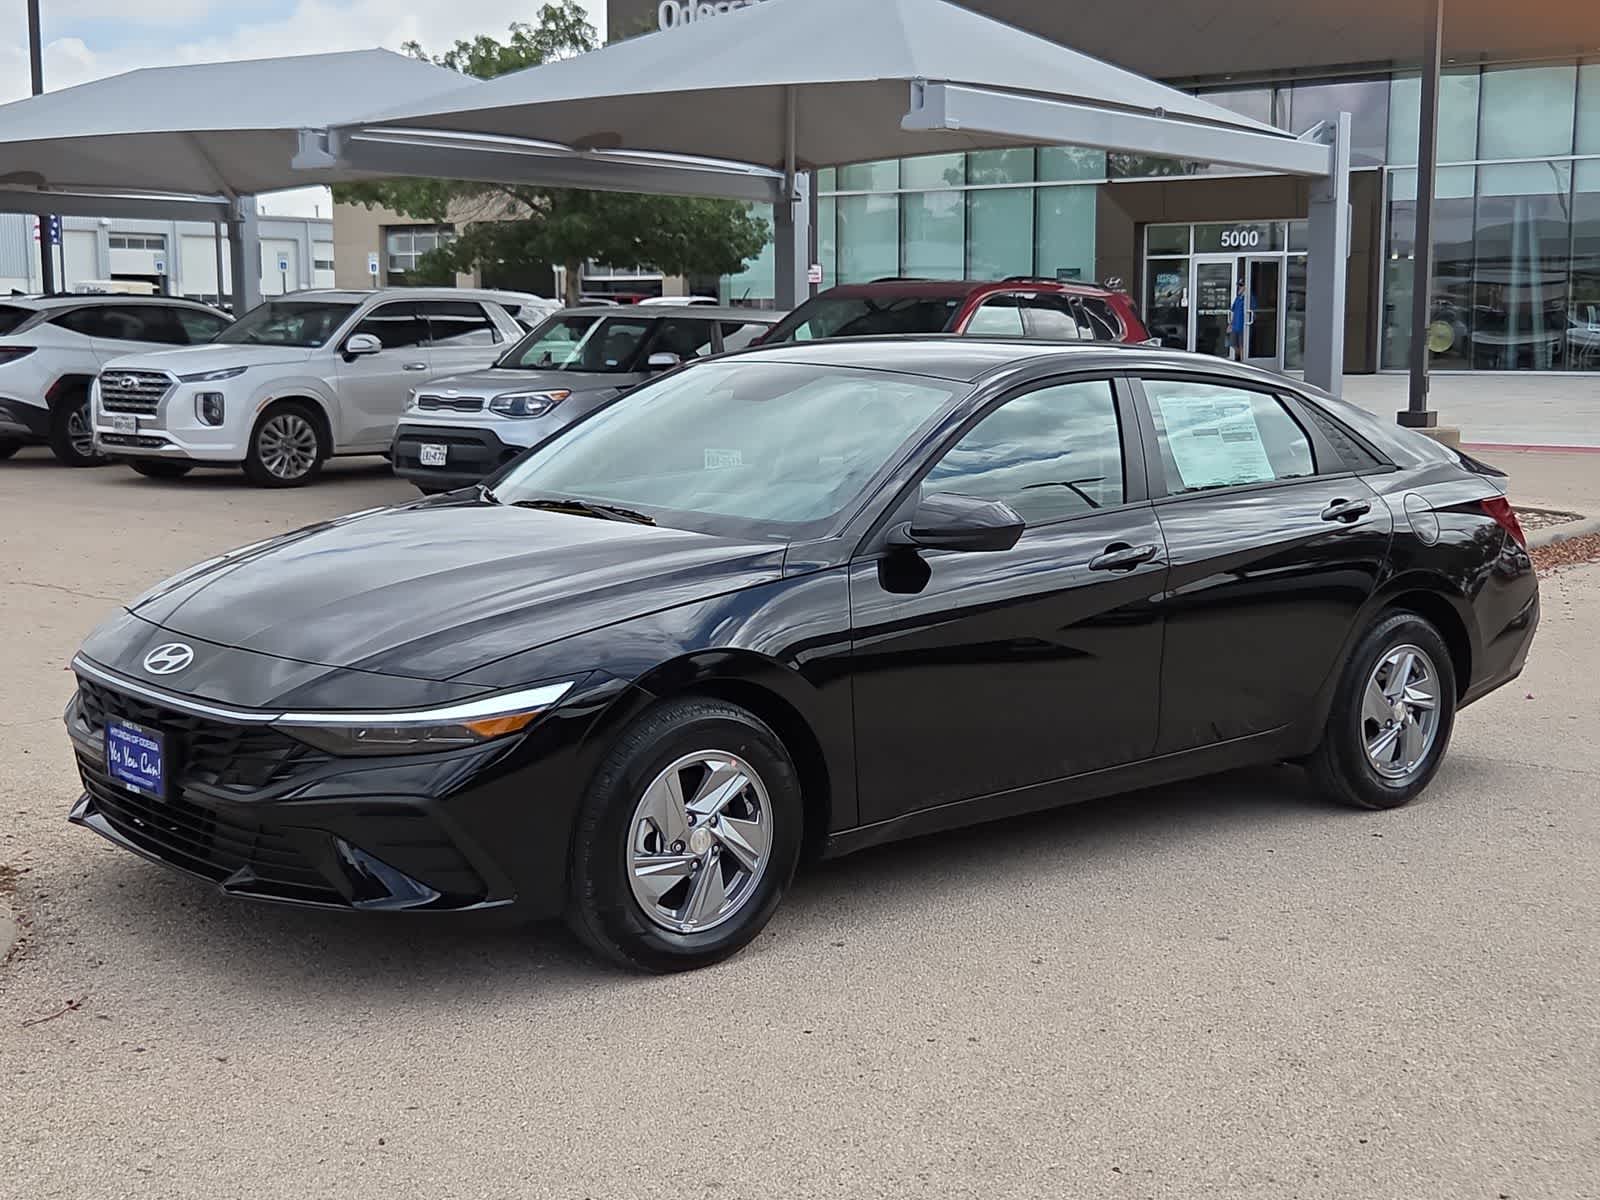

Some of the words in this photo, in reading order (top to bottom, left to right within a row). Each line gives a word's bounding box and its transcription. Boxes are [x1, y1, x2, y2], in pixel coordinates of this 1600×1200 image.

[1221, 231, 1258, 247] 5000
[110, 740, 121, 763] Yes
[123, 745, 138, 769] You
[140, 752, 161, 779] Can!
